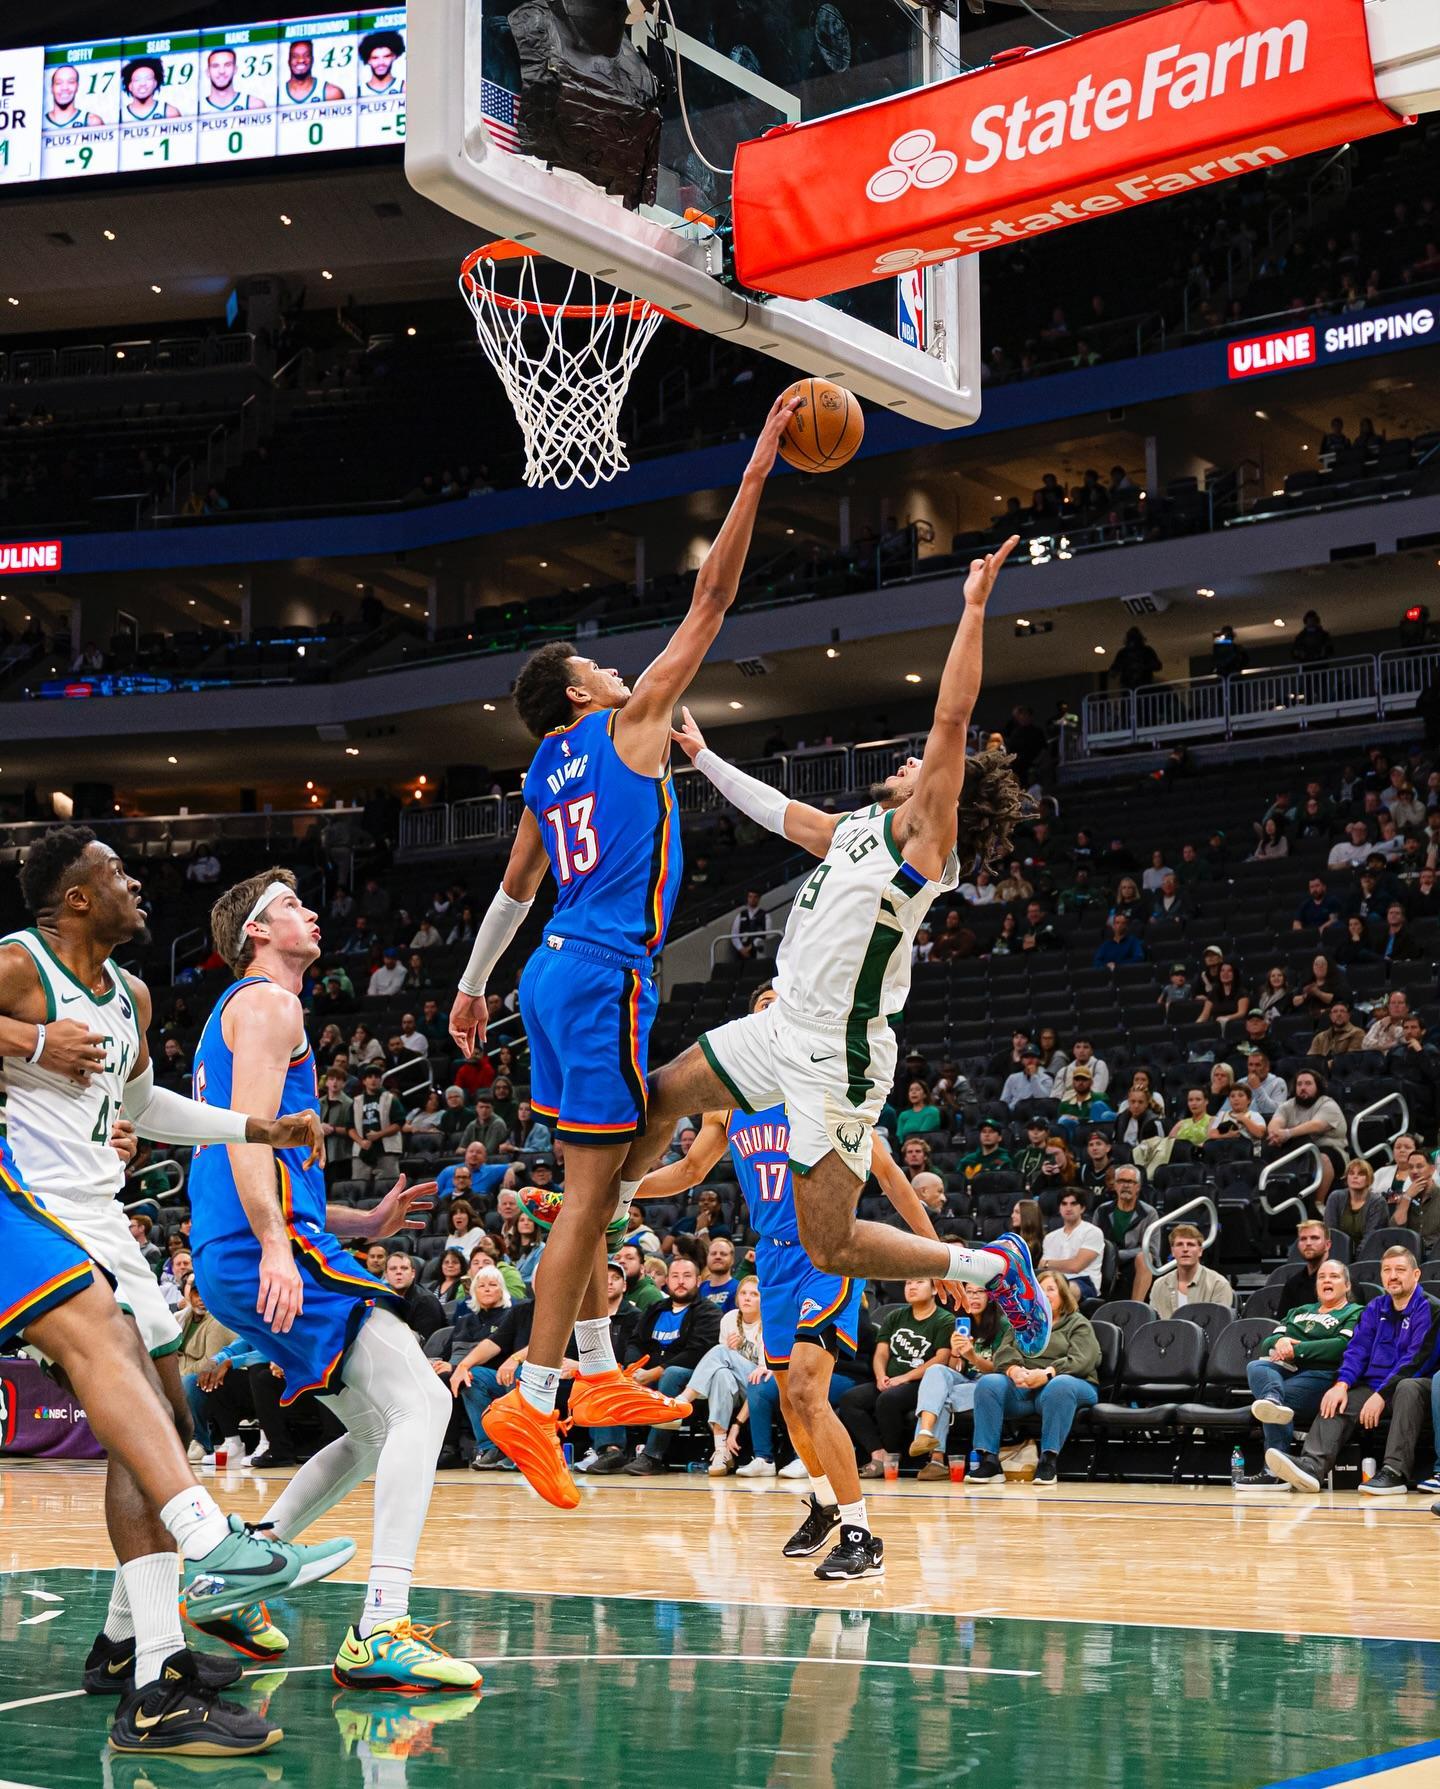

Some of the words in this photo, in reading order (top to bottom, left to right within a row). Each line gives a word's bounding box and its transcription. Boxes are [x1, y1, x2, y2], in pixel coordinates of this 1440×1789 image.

[241, 54, 273, 79] 35
[321, 45, 354, 68] 43
[86, 71, 115, 95] 17
[162, 63, 193, 86] 19
[202, 119, 228, 130] PLUS
[238, 114, 272, 125] MINUS
[282, 111, 308, 121] PLUS
[320, 105, 352, 116] MINUS
[45, 136, 71, 147] PLUS
[81, 131, 114, 142] MINUS
[124, 127, 149, 138] PLUS
[160, 122, 193, 134] MINUS
[309, 122, 323, 145] 0
[143, 138, 170, 161] -1
[228, 131, 243, 154] 0
[65, 146, 93, 170] -9
[901, 321, 915, 343] NBA
[1233, 332, 1310, 372] ULINE
[1324, 308, 1435, 353] SHIPPING
[1123, 596, 1157, 616] 106
[543, 791, 600, 886] 13
[730, 1123, 790, 1159] THUND
[754, 1161, 788, 1201] 17
[895, 1333, 920, 1358] BUCKS
[49, 1408, 68, 1419] NBC
